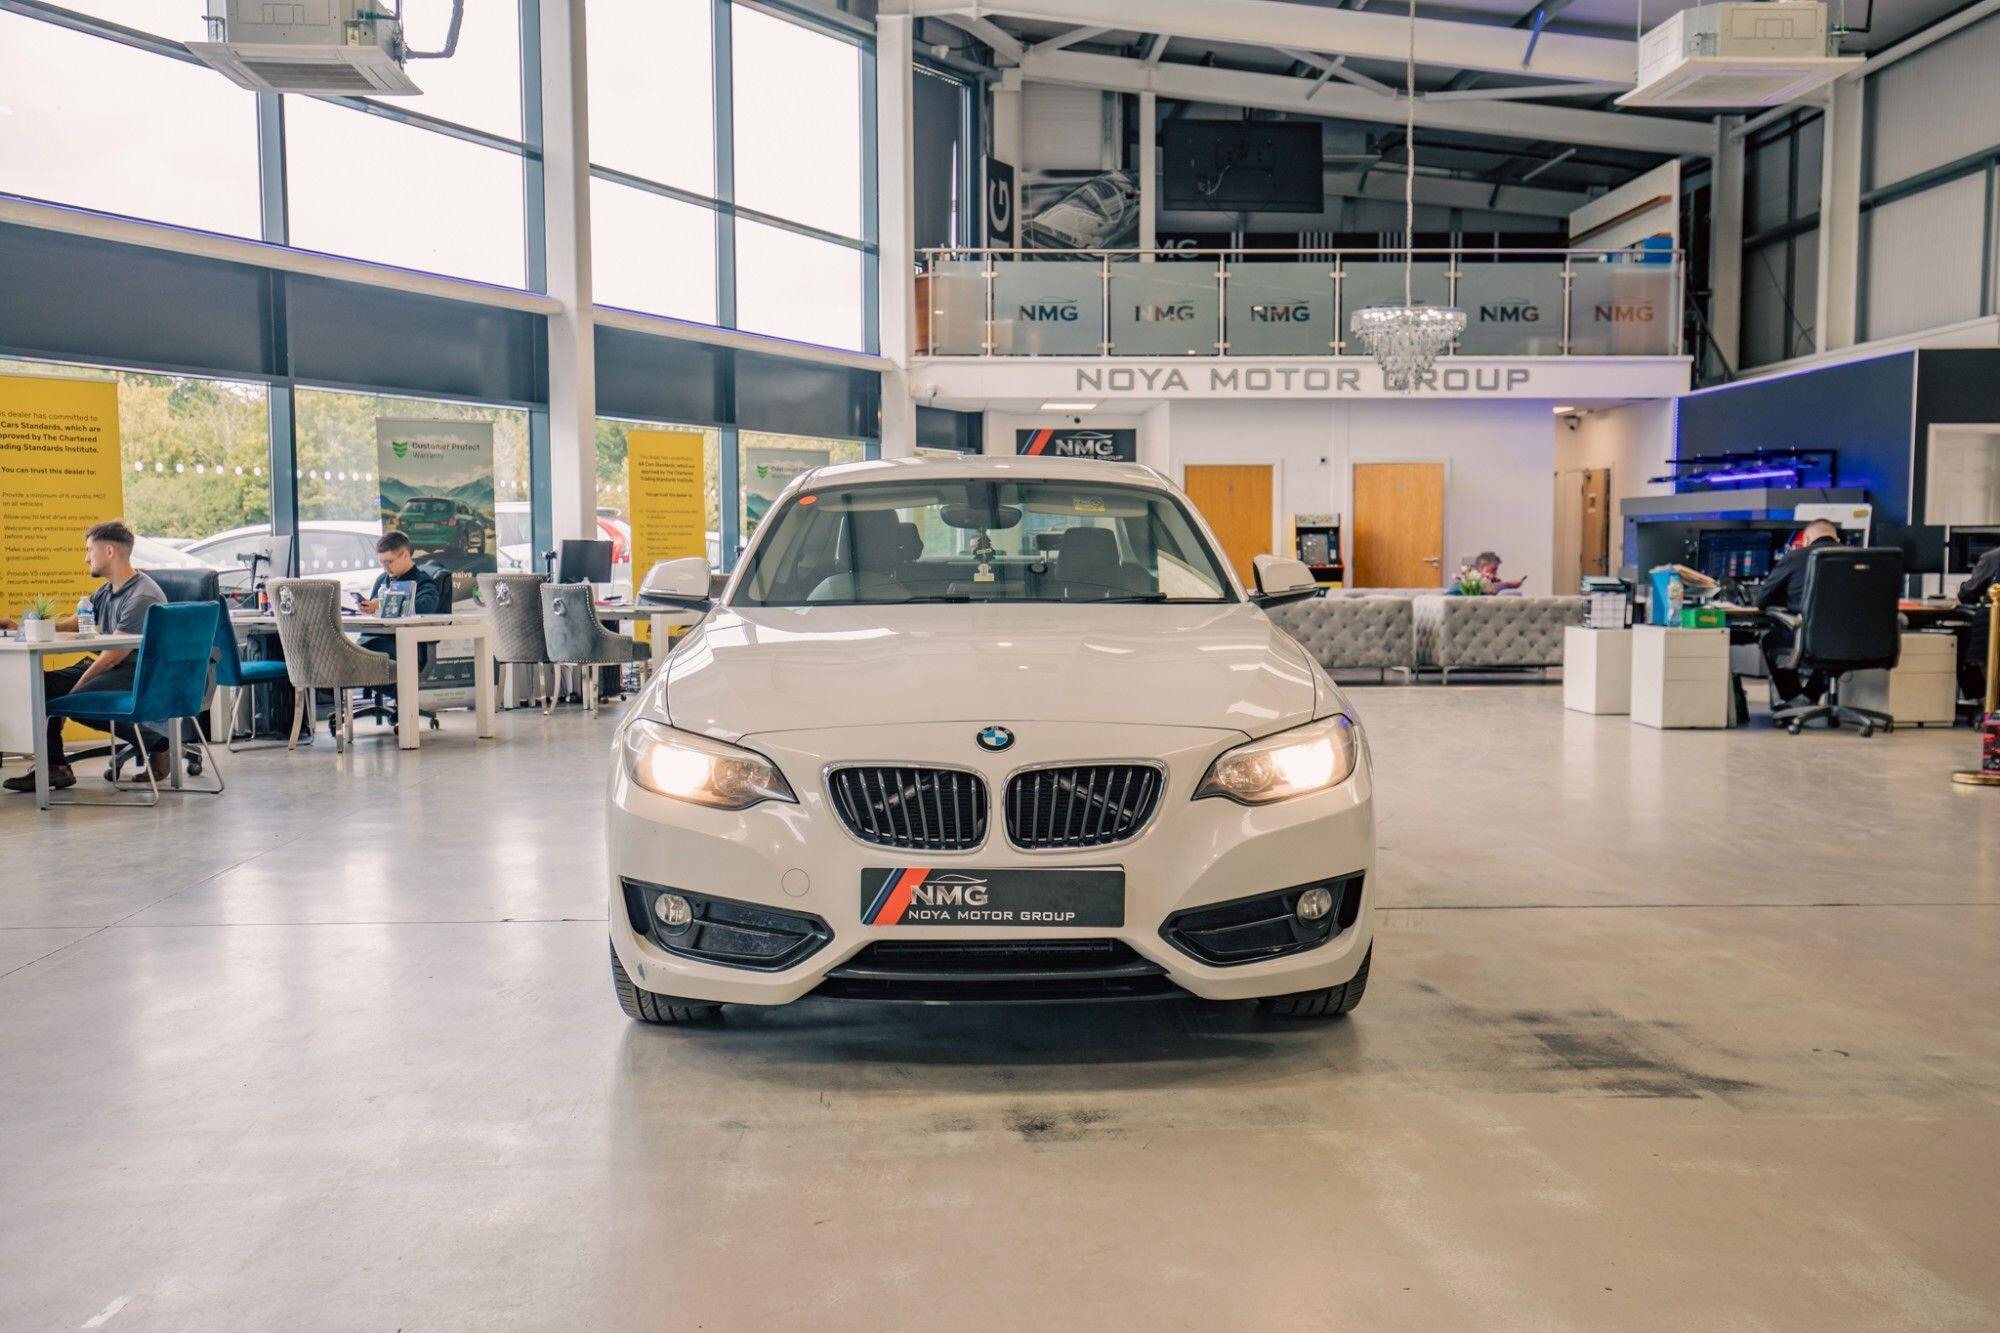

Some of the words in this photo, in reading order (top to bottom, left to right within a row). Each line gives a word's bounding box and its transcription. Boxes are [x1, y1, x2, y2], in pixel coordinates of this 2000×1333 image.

[1020, 305, 1079, 321] NMG
[1135, 305, 1195, 322] NMG
[1251, 305, 1310, 322] NMG
[1479, 305, 1539, 322] NMG
[1595, 305, 1654, 322] NMG
[1076, 368, 1189, 391] NOYA
[1210, 368, 1360, 391] MOTOR
[1384, 368, 1530, 391] GROUP
[48, 414, 89, 422] committed
[0, 421, 19, 429] Cars
[20, 422, 64, 432] Standards,
[32, 433, 41, 442] by
[59, 434, 98, 443] Chartered
[23, 444, 64, 452] Standards
[65, 446, 99, 454] Institute.
[451, 443, 480, 452] Protect
[1055, 439, 1114, 456] NMG
[1, 466, 15, 474] You
[910, 884, 988, 906] NMG
[908, 910, 951, 920] NOYA
[957, 910, 1013, 921] MOTOR
[1020, 911, 1076, 922] GROUP
